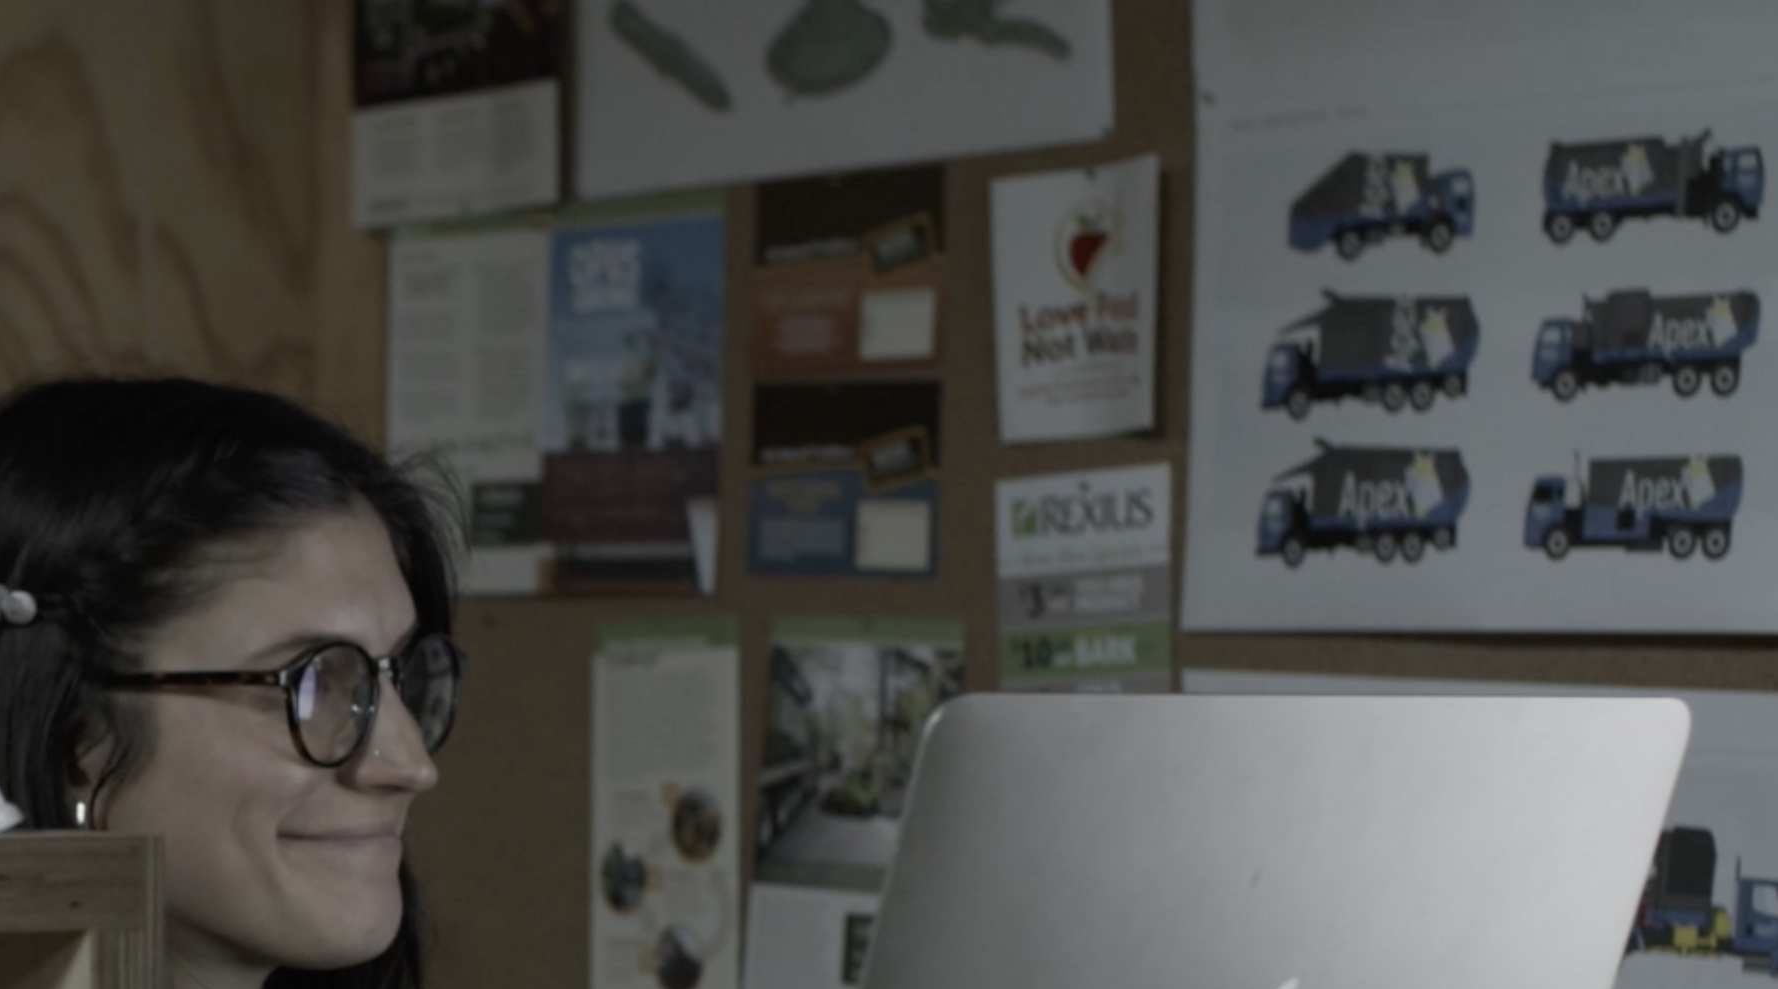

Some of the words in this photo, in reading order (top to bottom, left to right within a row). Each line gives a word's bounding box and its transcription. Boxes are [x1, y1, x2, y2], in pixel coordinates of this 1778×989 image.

[1562, 159, 1625, 208] Apex
[1018, 301, 1087, 333] Love
[1646, 312, 1711, 360] Apex
[1021, 333, 1076, 368] Not
[1040, 486, 1154, 536] REXIUS
[1338, 469, 1412, 529] Apex
[1618, 469, 1686, 521] Apex
[1074, 633, 1138, 669] BARK
